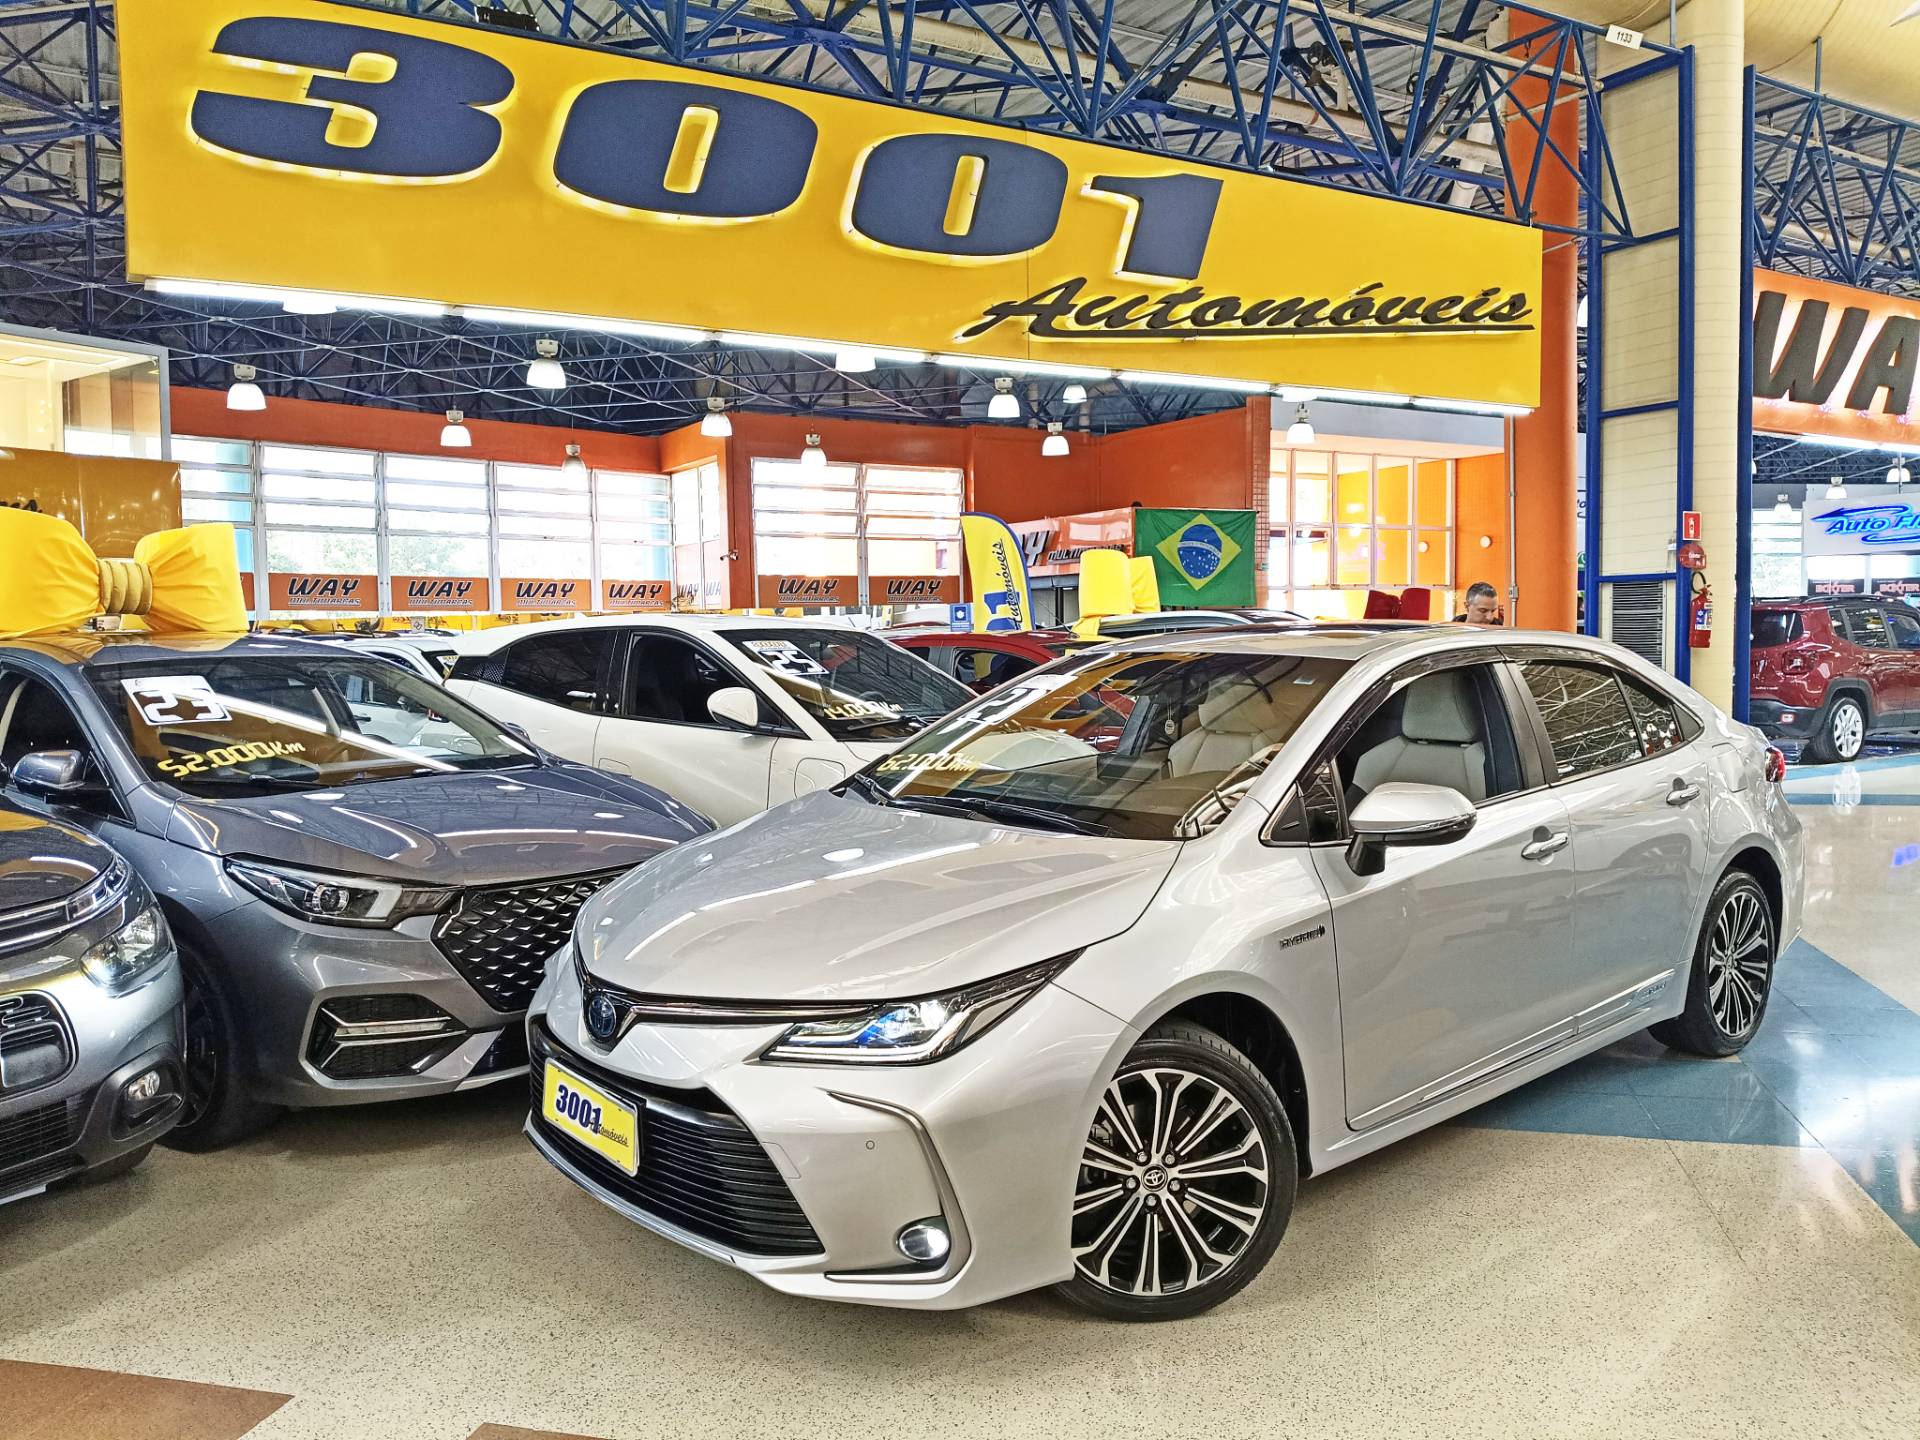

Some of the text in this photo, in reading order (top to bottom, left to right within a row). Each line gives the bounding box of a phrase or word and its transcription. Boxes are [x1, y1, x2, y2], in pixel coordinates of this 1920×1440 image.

[1616, 31, 1633, 44] 1133
[190, 15, 1221, 280] 3001
[960, 276, 1536, 338] Automóveis
[1825, 516, 1887, 534] Auto
[287, 577, 360, 596] WAY
[407, 579, 474, 597] WAY
[515, 582, 576, 598] WAY
[608, 583, 664, 599] WAY
[778, 579, 838, 595] WAY
[887, 580, 943, 595] WAY
[761, 650, 823, 673] 25
[141, 689, 227, 722] 23
[555, 1084, 602, 1136] 3001
